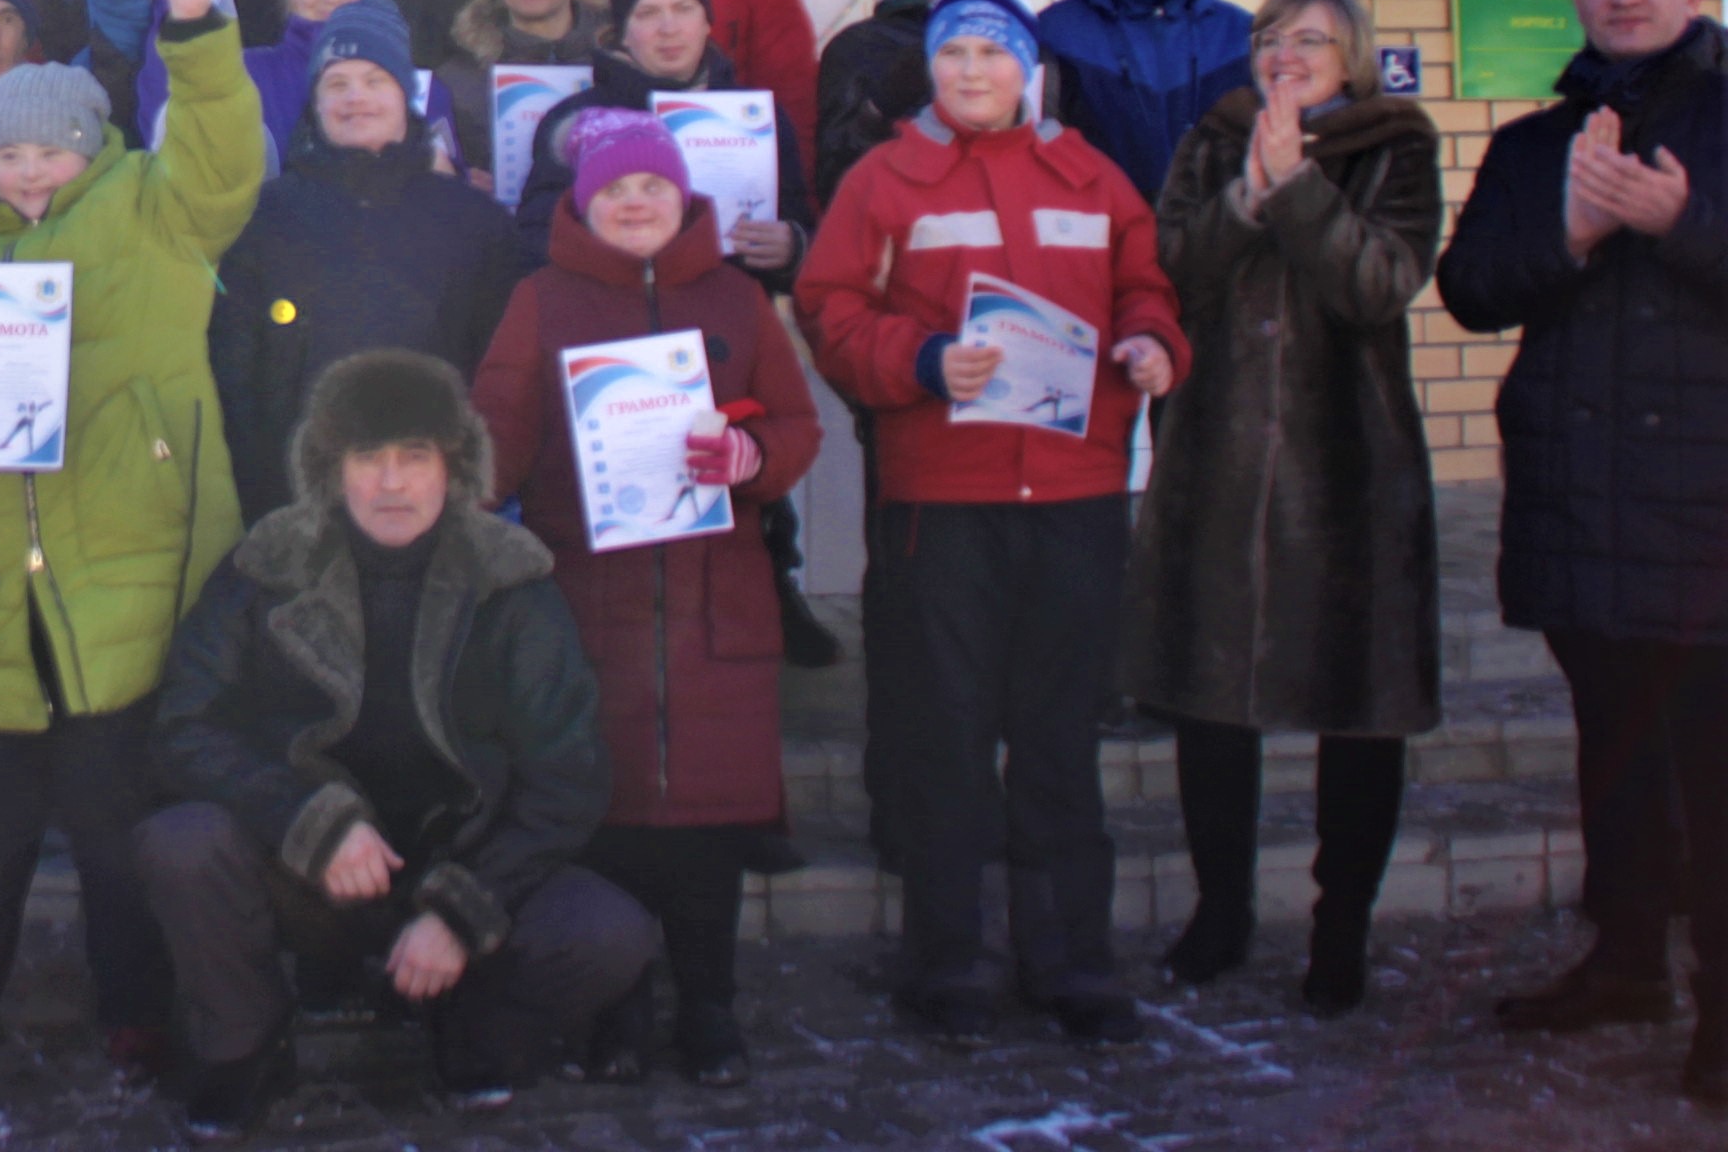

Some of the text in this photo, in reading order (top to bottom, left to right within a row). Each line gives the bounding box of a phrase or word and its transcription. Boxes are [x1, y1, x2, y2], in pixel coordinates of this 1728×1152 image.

[685, 137, 758, 147] ГРАМОТА
[999, 321, 1078, 357] ГРАМОТА
[607, 392, 692, 416] ГРАМОТА
